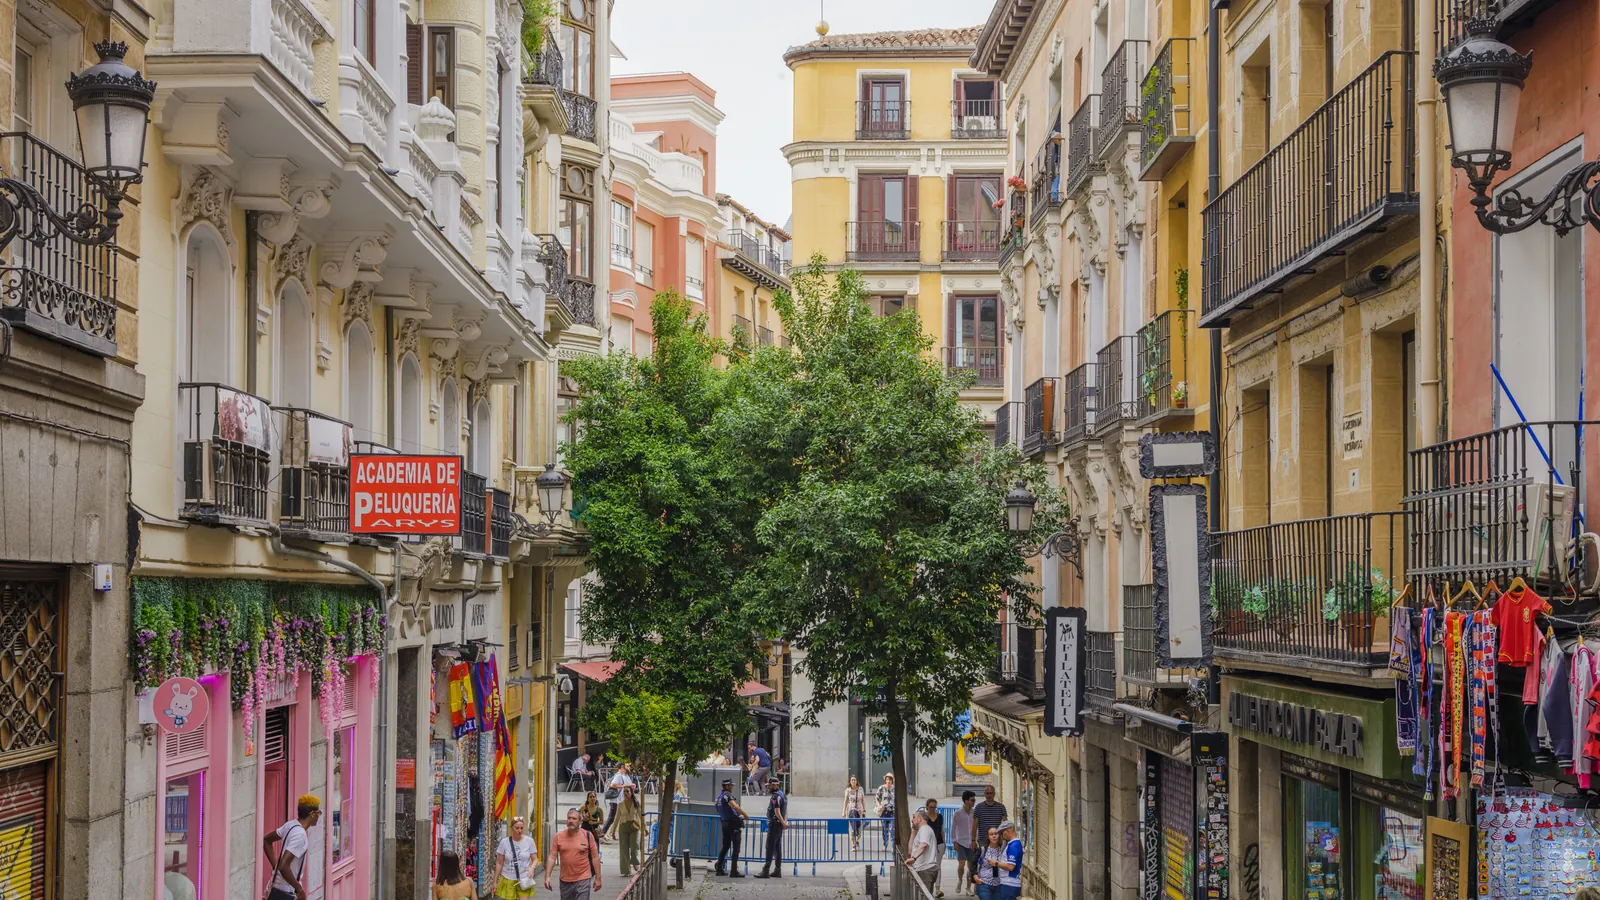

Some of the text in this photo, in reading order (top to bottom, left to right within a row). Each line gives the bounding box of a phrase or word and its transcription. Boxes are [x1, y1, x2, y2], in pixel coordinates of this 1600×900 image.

[356, 462, 456, 484] ACADEMIA DE
[354, 488, 456, 527] PELUQUERÍA
[434, 604, 455, 630] MUNDO
[1059, 643, 1072, 726] FILATELIA
[1228, 691, 1304, 744] ALIMENTACION
[1314, 708, 1364, 758] BAZAR
